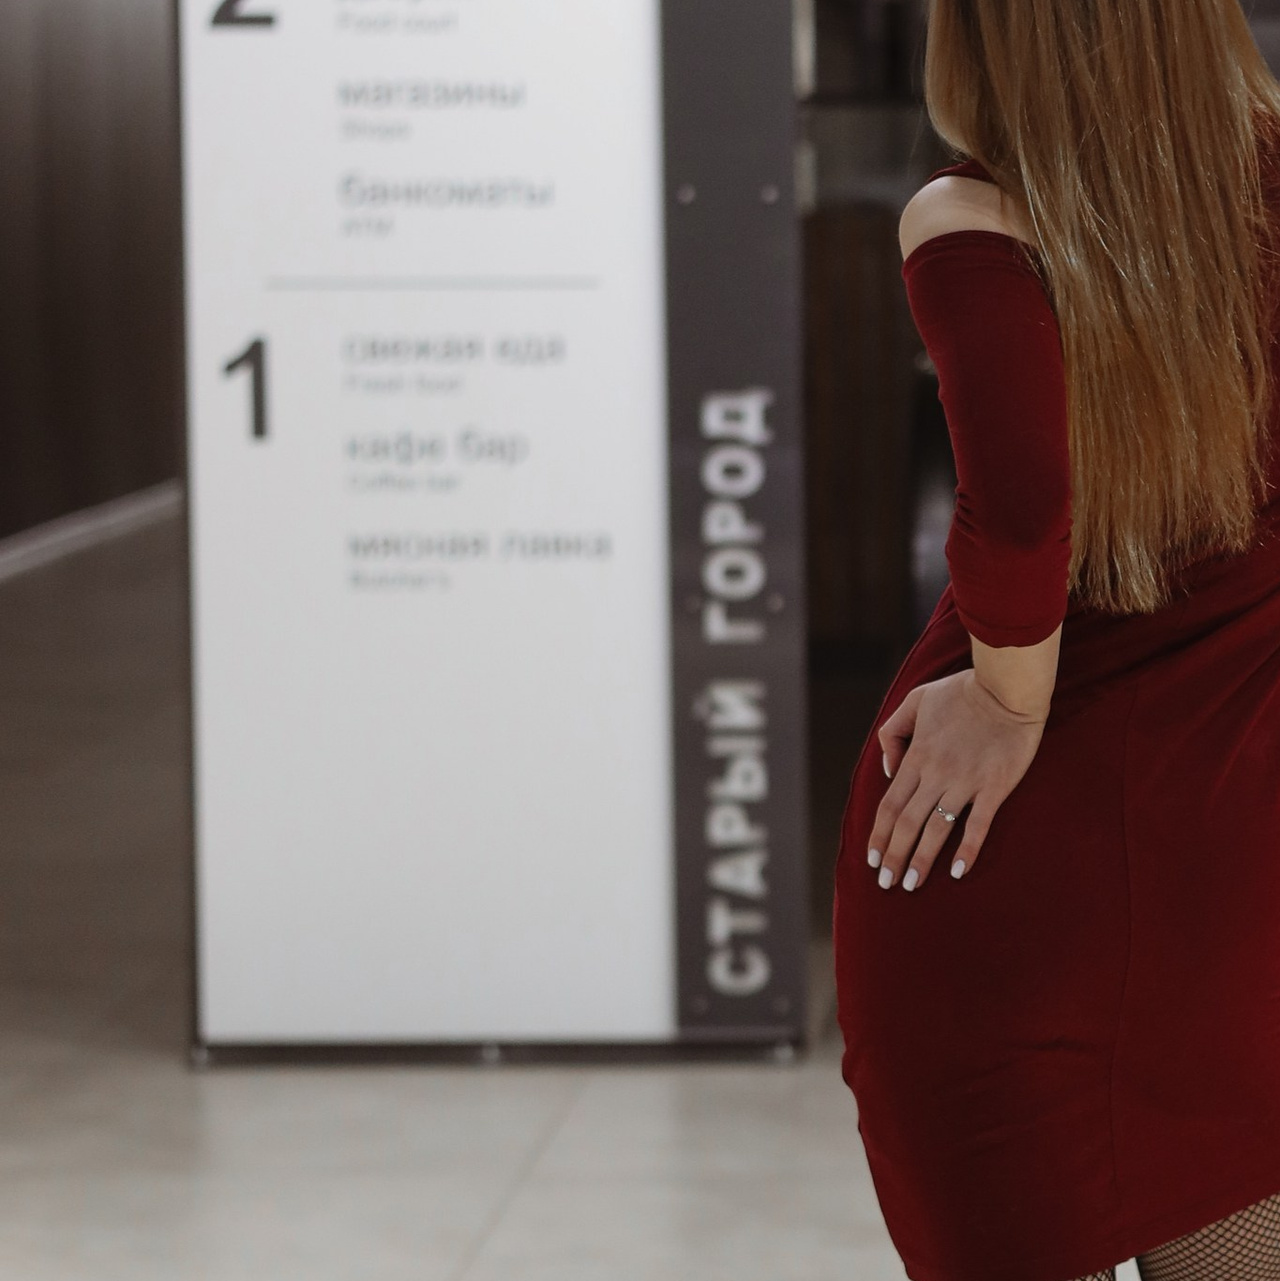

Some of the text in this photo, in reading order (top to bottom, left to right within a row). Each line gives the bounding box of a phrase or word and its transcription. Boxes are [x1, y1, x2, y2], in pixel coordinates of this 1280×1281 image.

[337, 80, 526, 111] магазины
[338, 171, 555, 209] банкоматы
[223, 336, 268, 442] 1
[345, 426, 530, 468] кафе бар
[696, 388, 775, 997] СТАРЫЙ ГОРОД
